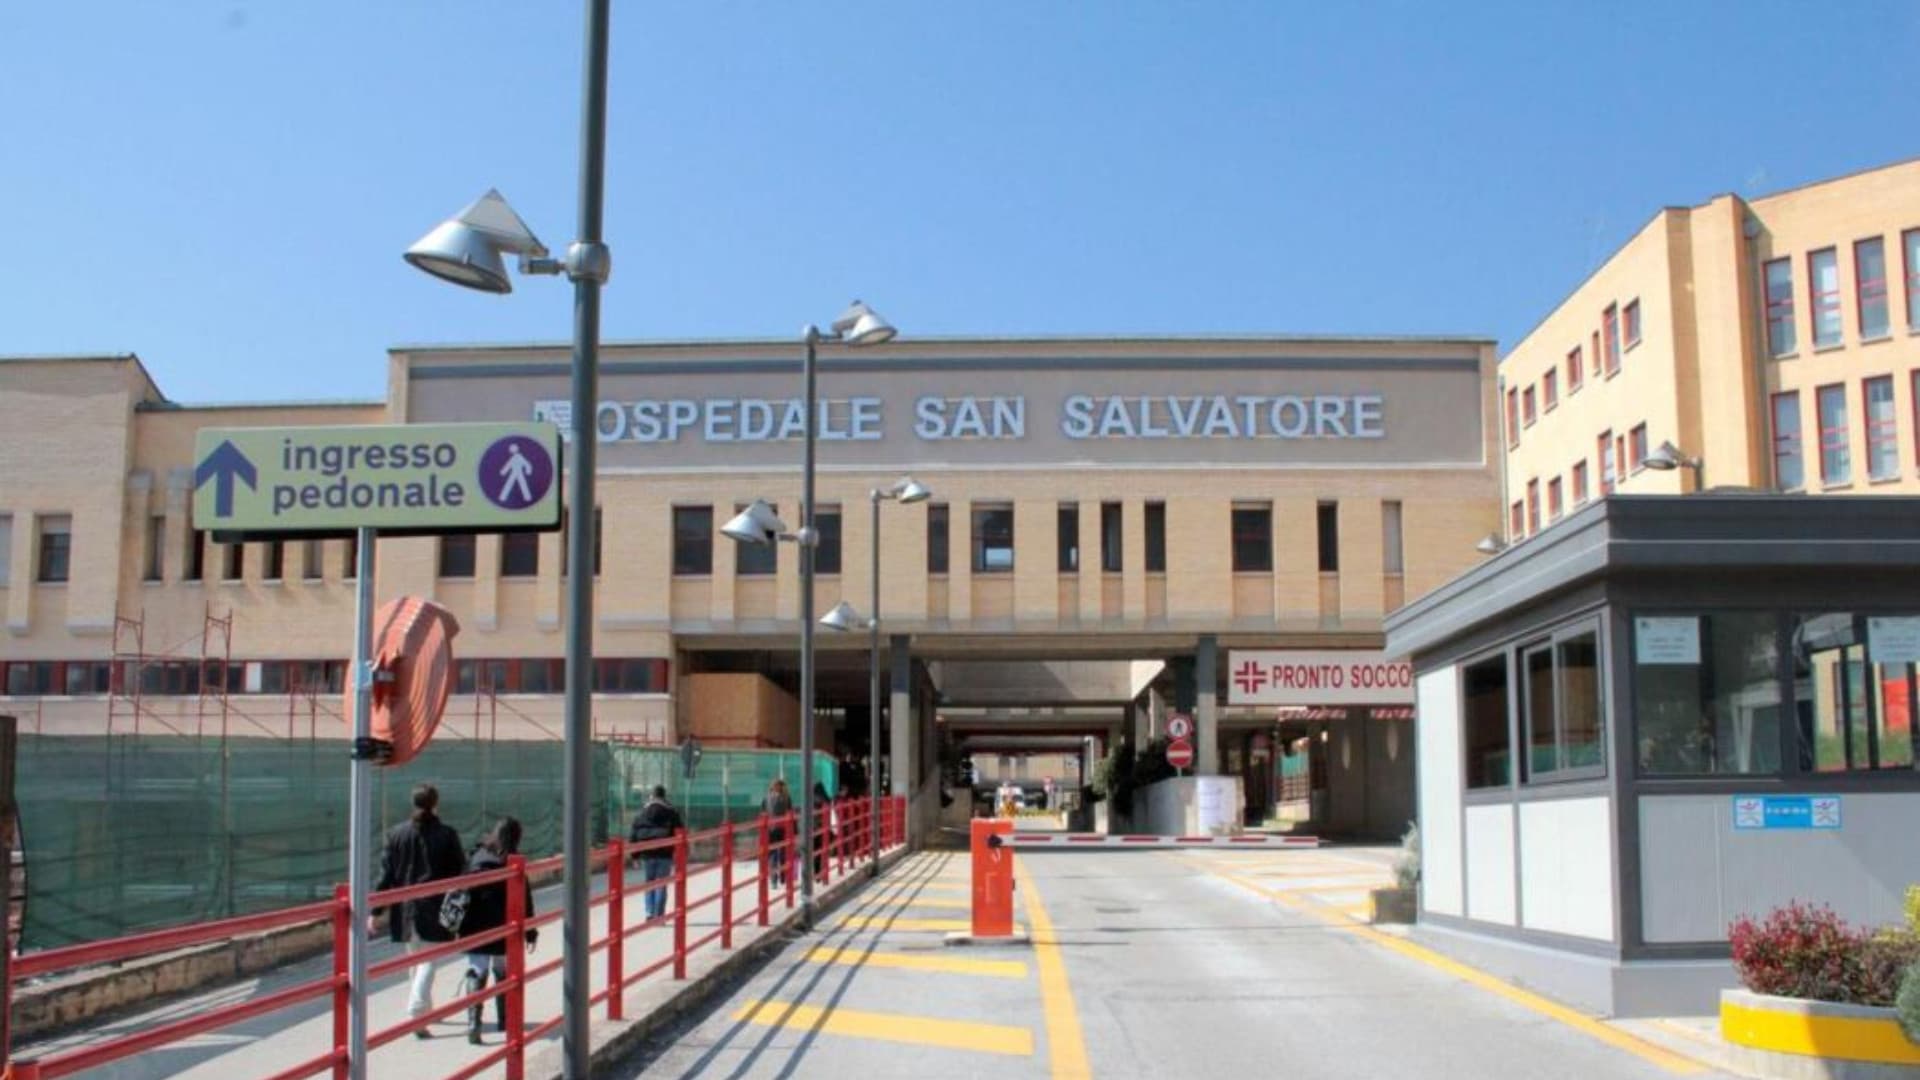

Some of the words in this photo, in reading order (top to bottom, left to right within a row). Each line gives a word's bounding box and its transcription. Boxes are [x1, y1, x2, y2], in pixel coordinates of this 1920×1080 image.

[596, 398, 881, 442] OSPEDALE
[915, 396, 1025, 440] SAN
[1062, 395, 1384, 438] SALVATORE
[283, 438, 457, 474] ingresso
[273, 473, 464, 515] pedonale
[1272, 664, 1343, 689] PRONTO
